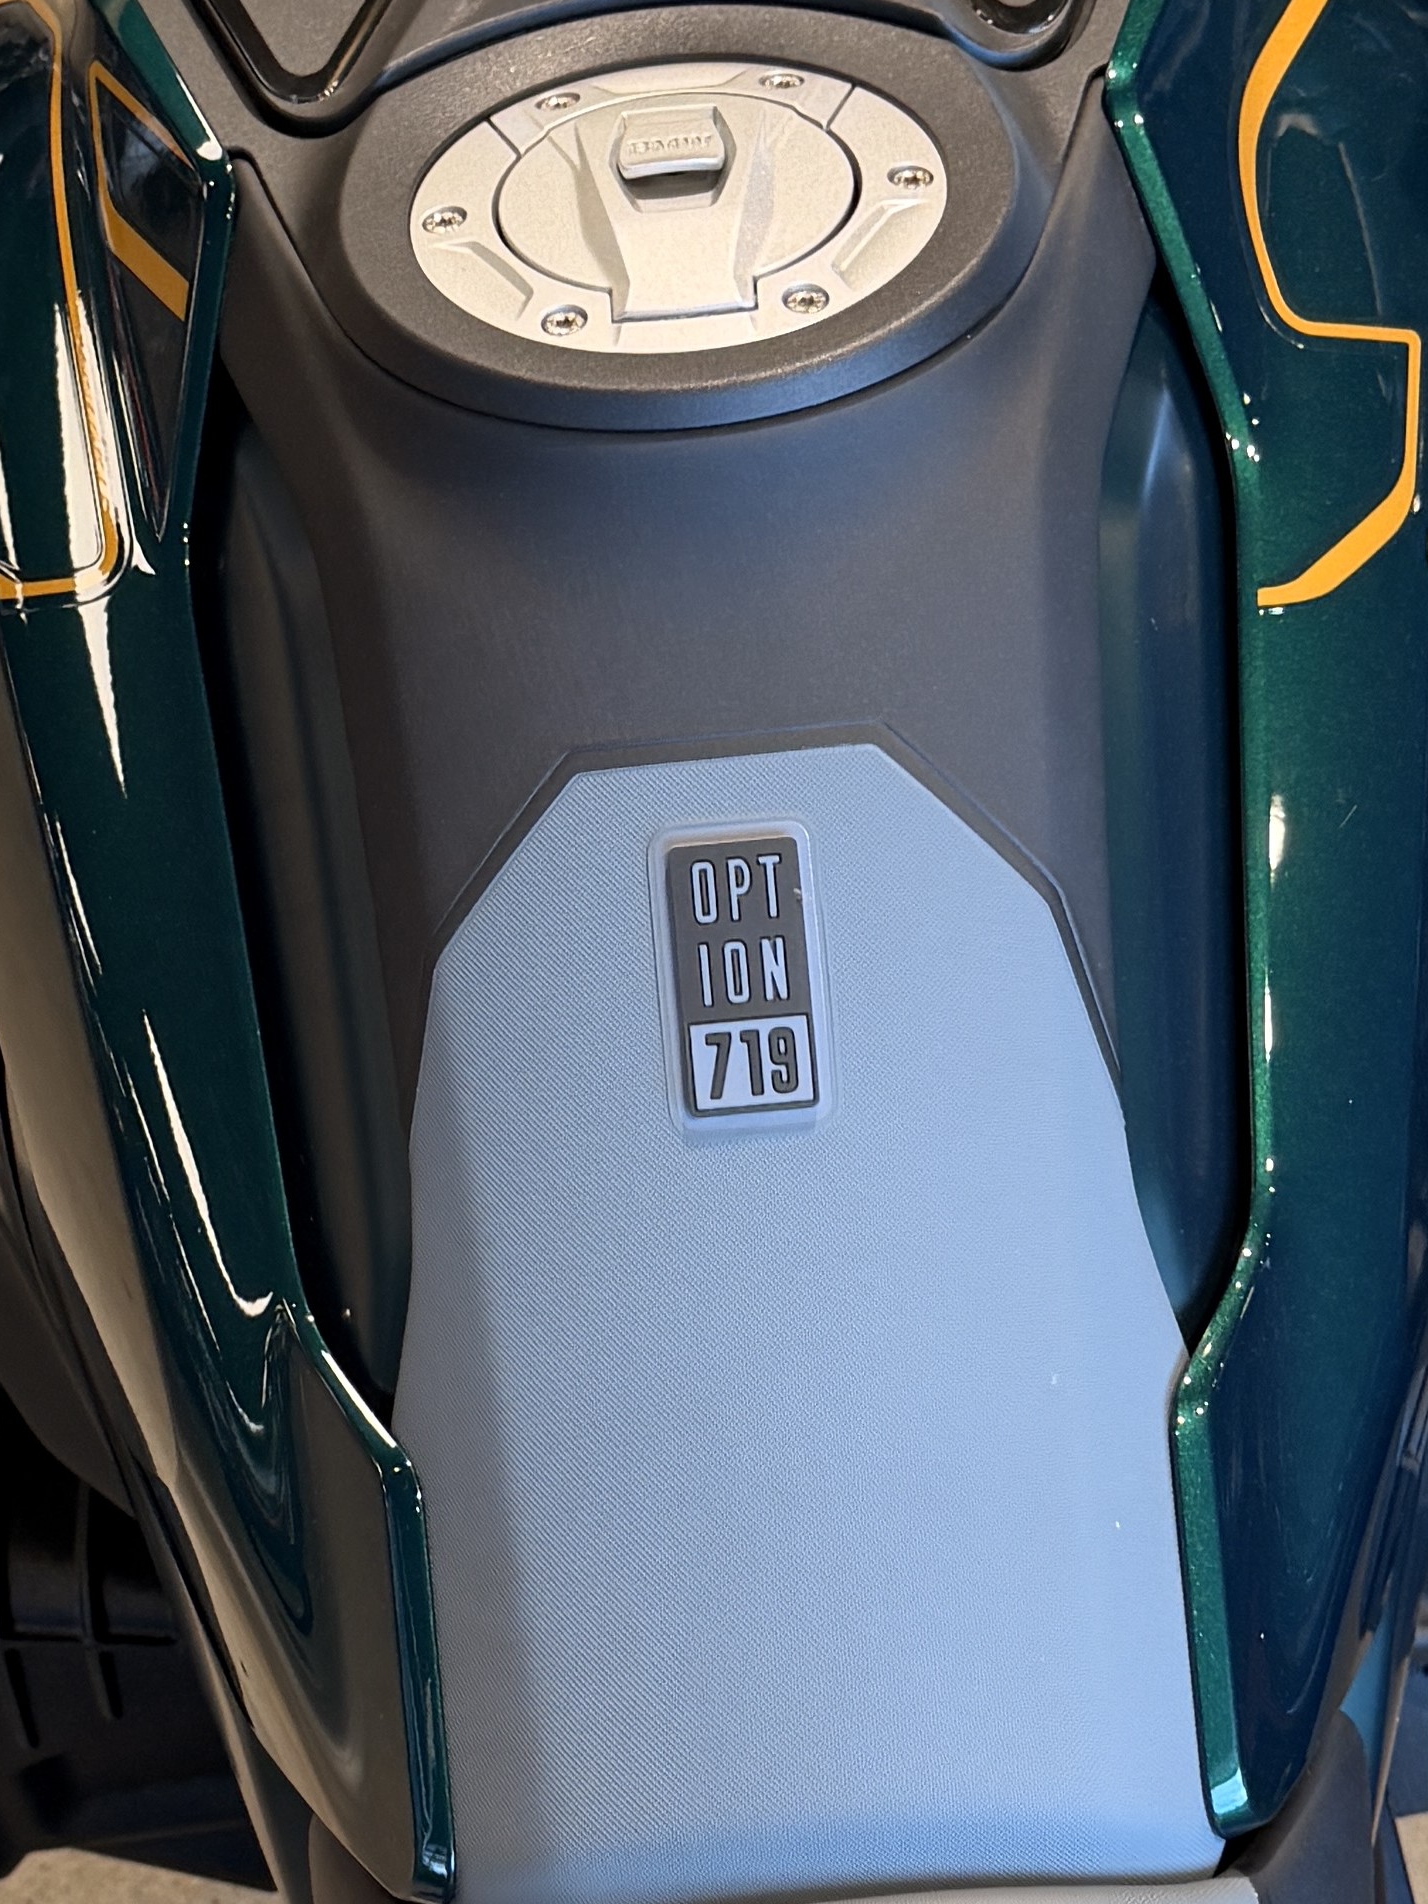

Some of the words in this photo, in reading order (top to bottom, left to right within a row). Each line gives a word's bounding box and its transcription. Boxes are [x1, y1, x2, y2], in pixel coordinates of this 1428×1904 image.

[689, 853, 782, 924] OPT
[697, 935, 790, 1007] ION
[705, 1026, 800, 1100] 719
